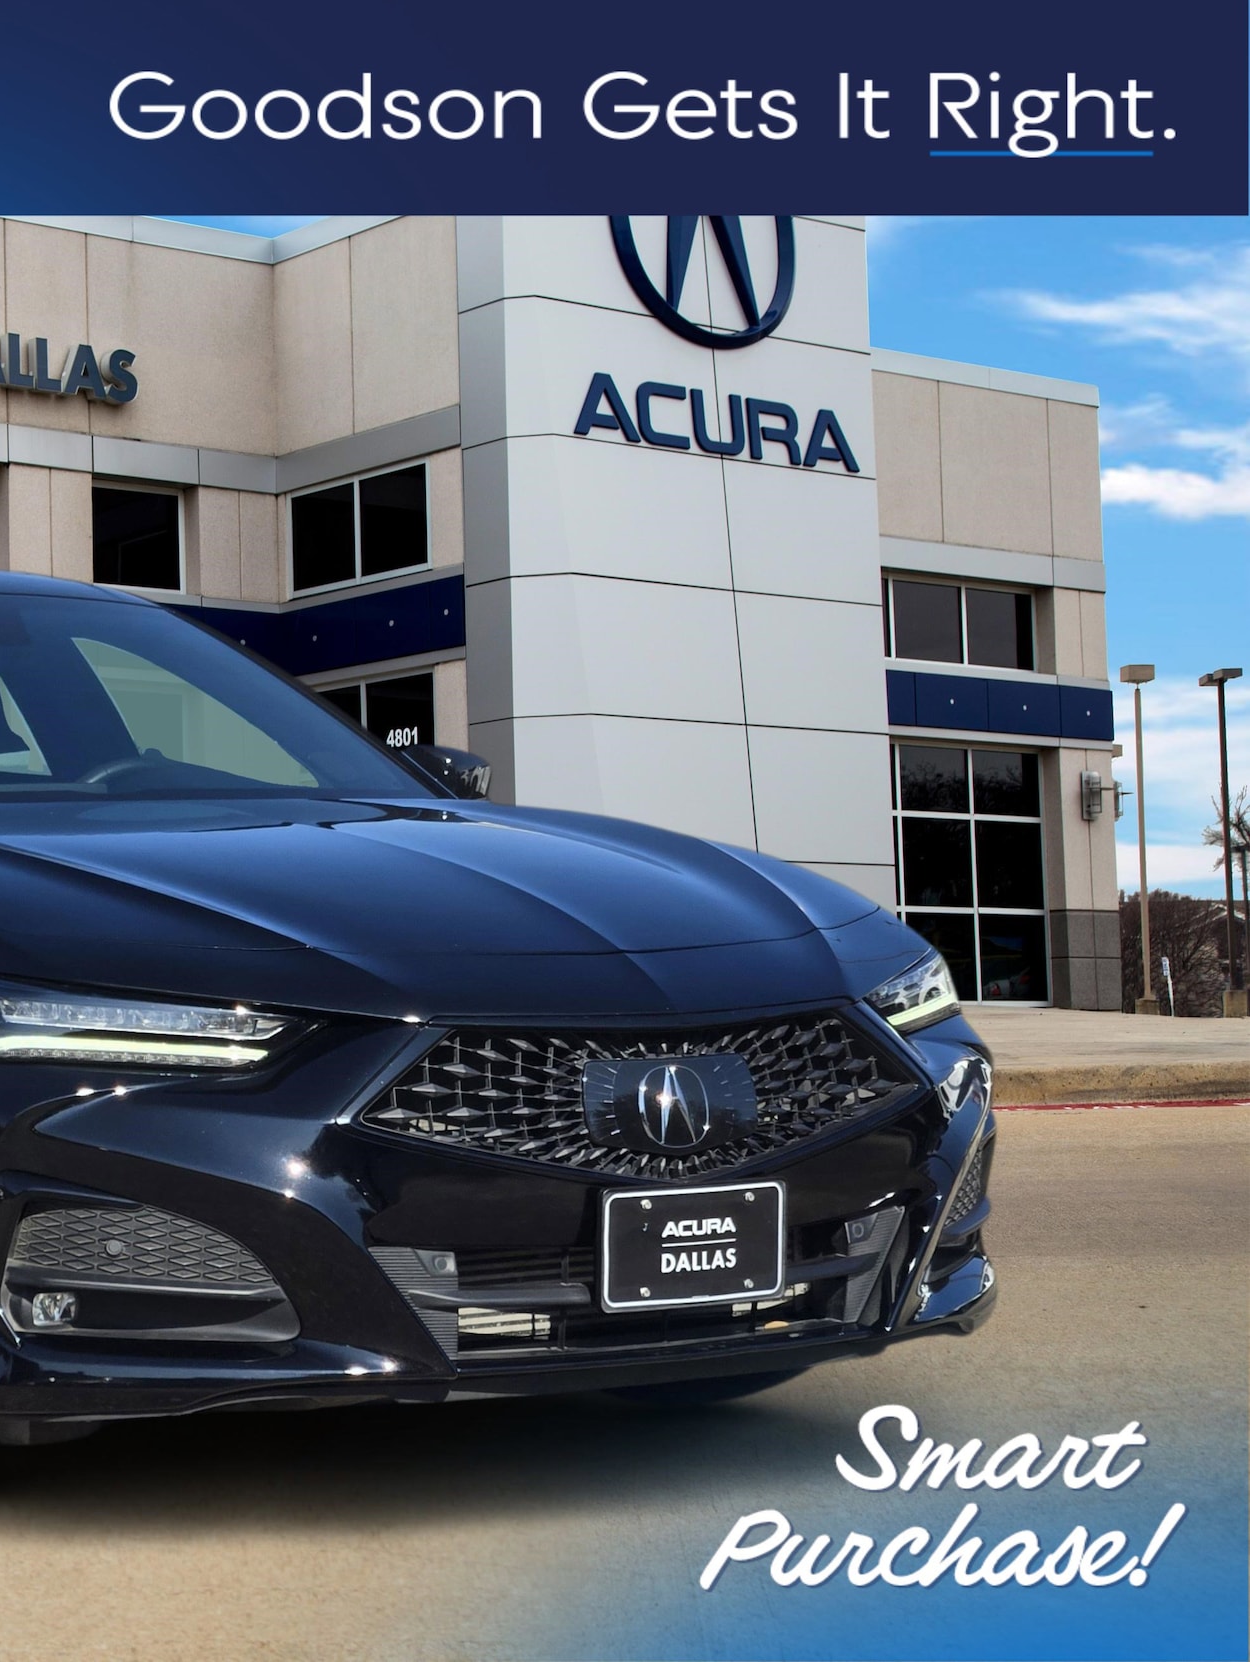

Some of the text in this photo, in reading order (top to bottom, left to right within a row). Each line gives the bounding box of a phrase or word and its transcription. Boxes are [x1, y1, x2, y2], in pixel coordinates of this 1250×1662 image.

[574, 372, 860, 473] ACURA
[386, 726, 418, 747] 4801
[661, 1217, 736, 1238] ACURA
[661, 1248, 737, 1273] DALLAS
